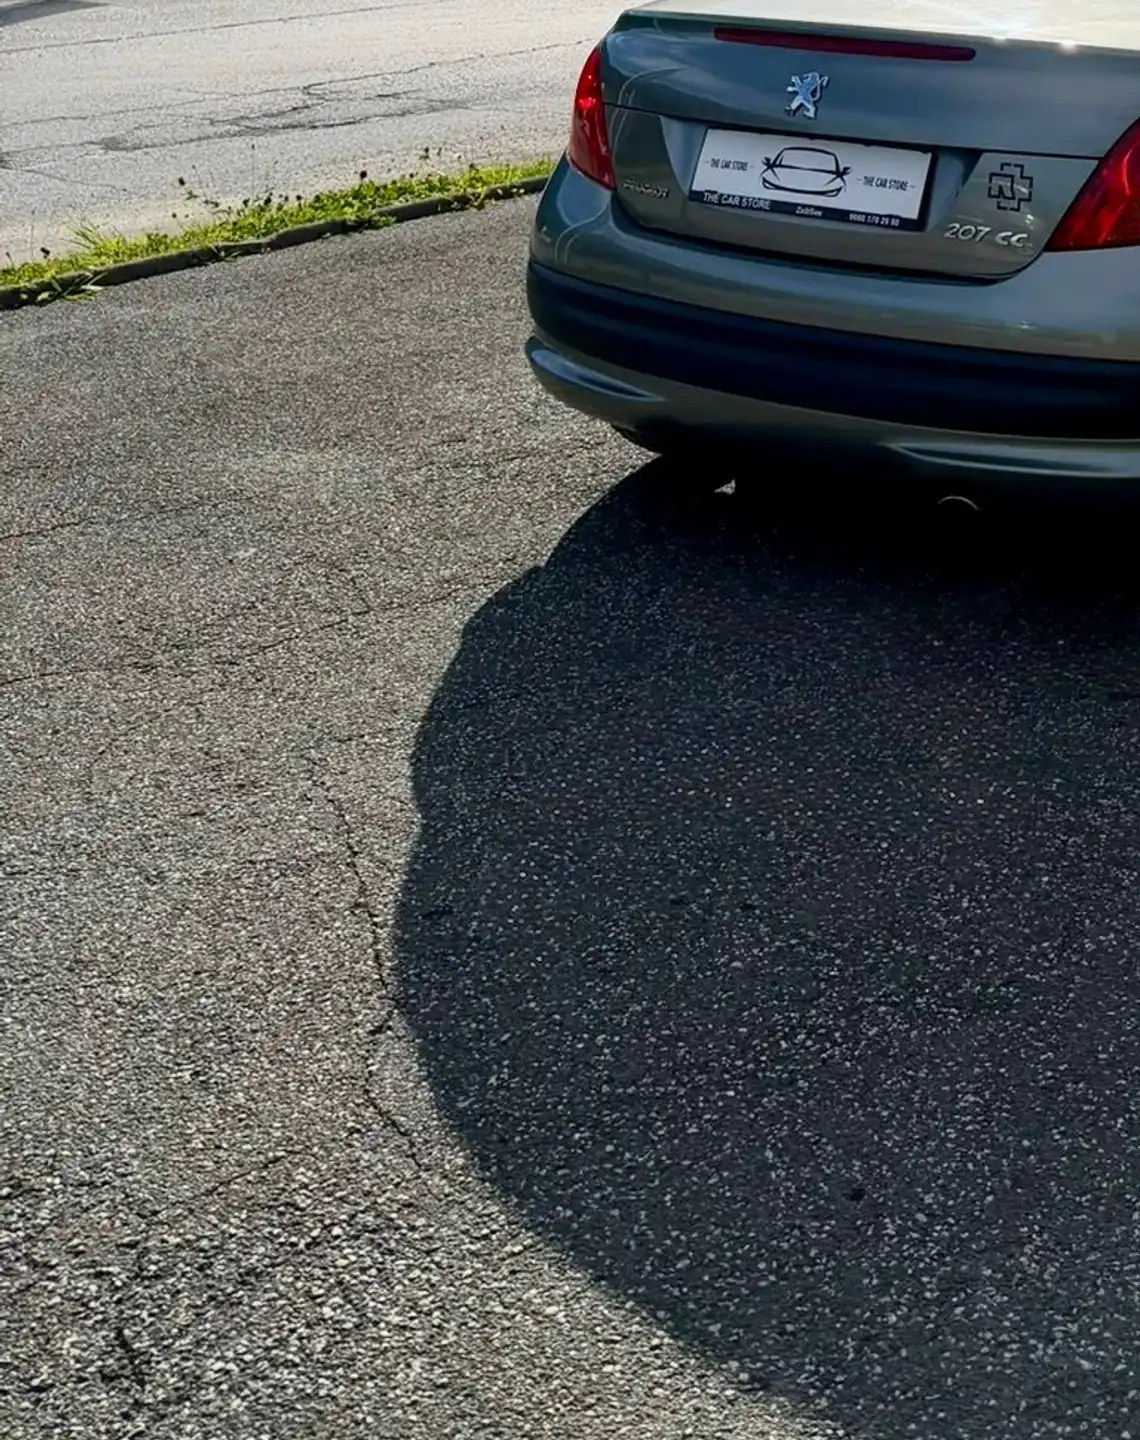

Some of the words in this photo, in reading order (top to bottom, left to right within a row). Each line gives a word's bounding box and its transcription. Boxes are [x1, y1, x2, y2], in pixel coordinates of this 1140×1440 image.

[703, 192, 720, 204] THE
[721, 195, 740, 206] CAR
[742, 197, 771, 210] STORE
[944, 223, 991, 244] 207
